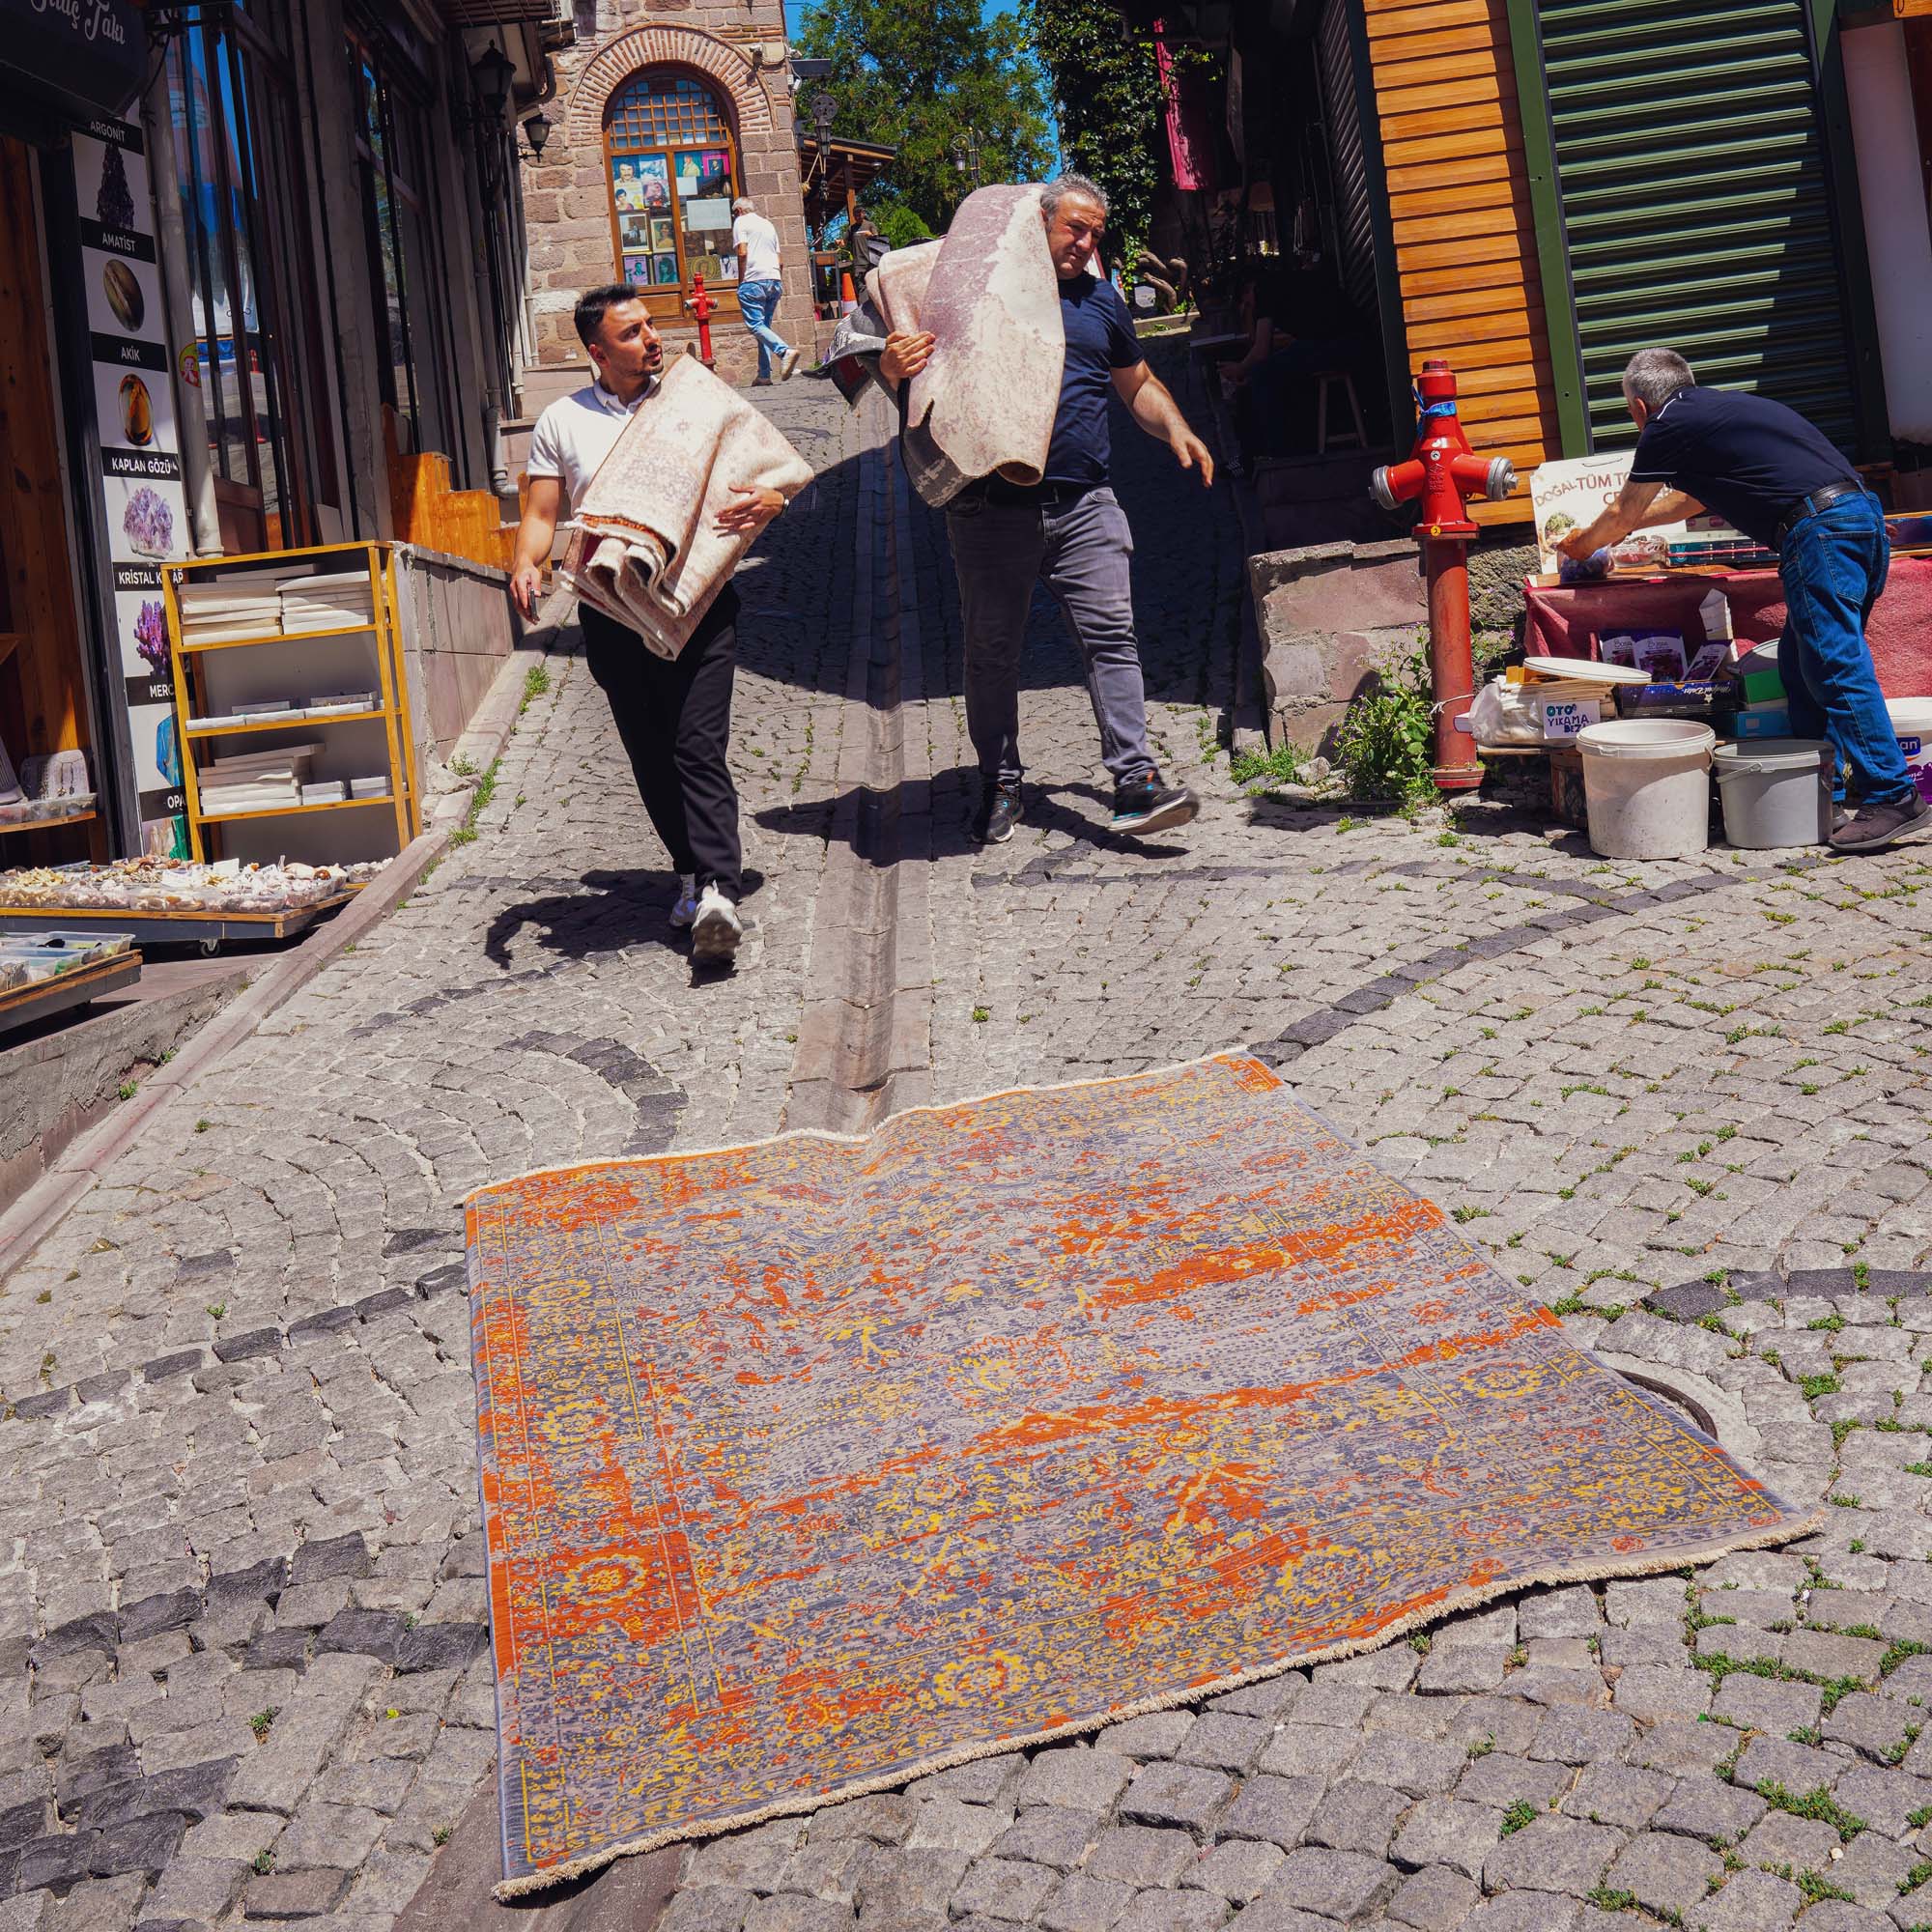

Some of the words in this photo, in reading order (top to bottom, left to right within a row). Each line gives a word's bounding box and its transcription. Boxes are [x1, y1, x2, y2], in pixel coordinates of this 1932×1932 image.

[90, 121, 126, 143] ARGONİT
[102, 232, 136, 252] AMATİST
[121, 345, 141, 362] AKİK
[111, 457, 146, 472] KAPLAN
[147, 458, 171, 474] GÖZÜ
[1534, 480, 1577, 507] DOĞAL
[1576, 473, 1611, 491] TÜM
[118, 568, 155, 585] KRİSTAL
[1548, 714, 1589, 726] YIKAMA
